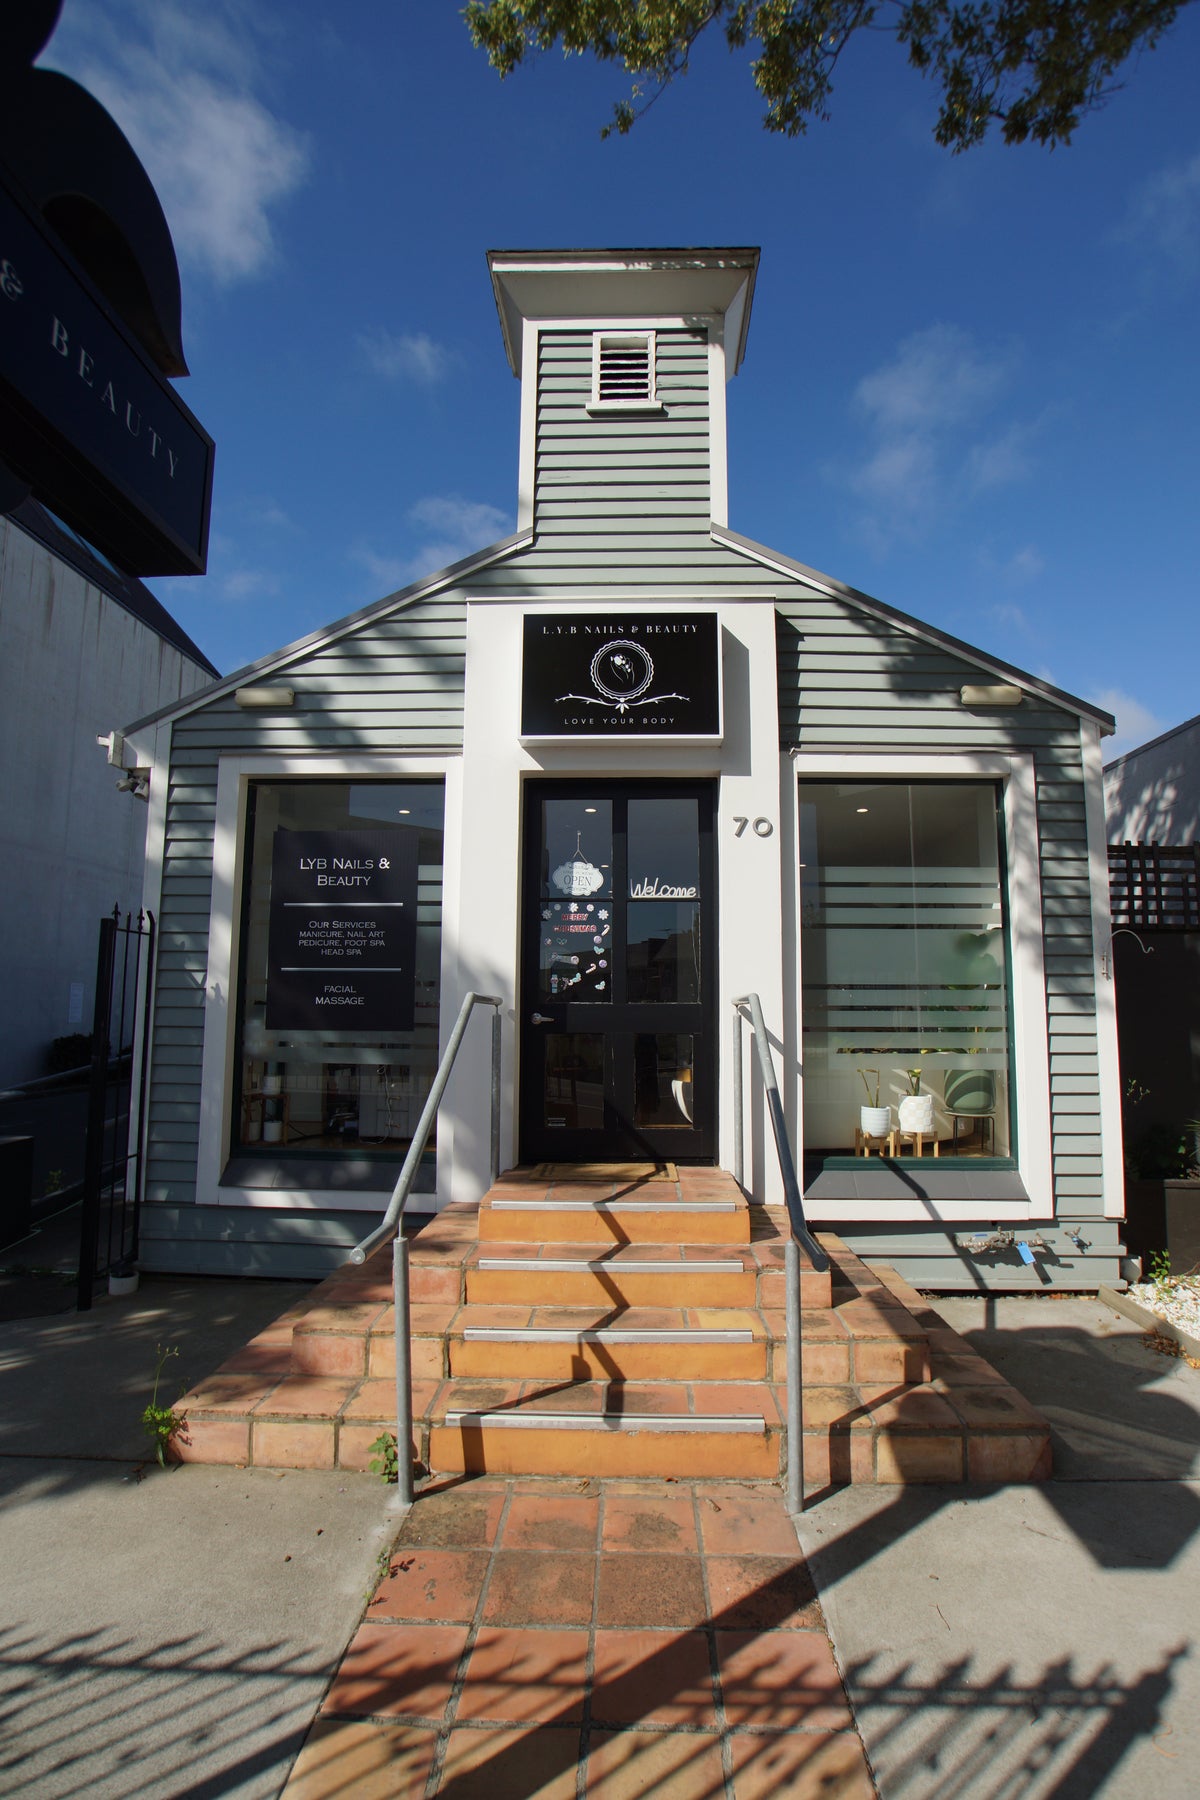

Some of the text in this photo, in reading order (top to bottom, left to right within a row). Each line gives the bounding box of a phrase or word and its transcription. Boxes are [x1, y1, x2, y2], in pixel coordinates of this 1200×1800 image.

[0, 258, 180, 480] & BEAUTY
[543, 624, 699, 634] L.Y.B NAILS & BEAUTY
[643, 717, 676, 725] BODY
[732, 816, 773, 838] 70
[300, 858, 327, 870] LYB
[378, 857, 390, 869] &
[563, 874, 592, 886] OPEN
[630, 877, 697, 897] Welcome
[561, 913, 589, 921] MERRY
[553, 924, 597, 933] STMAS
[299, 931, 345, 939] MANICURE,
[344, 939, 367, 947] FOOT
[369, 939, 385, 947] SPA
[321, 948, 362, 956] HEAD SPA
[324, 985, 356, 993] FACIAL
[315, 997, 365, 1005] MASSAGE
